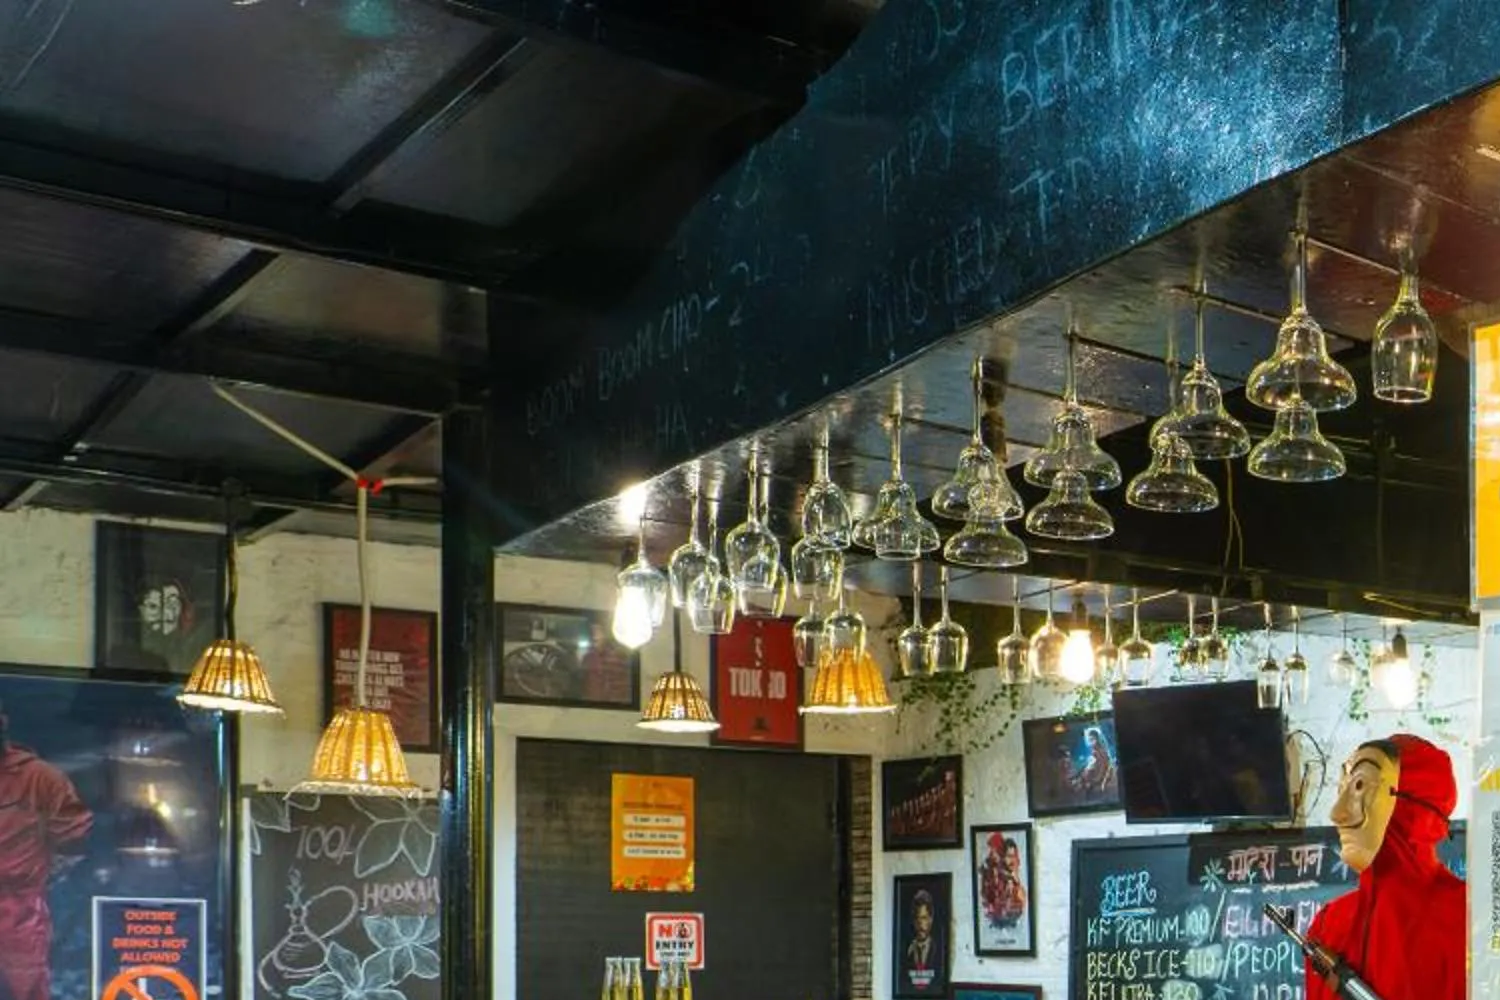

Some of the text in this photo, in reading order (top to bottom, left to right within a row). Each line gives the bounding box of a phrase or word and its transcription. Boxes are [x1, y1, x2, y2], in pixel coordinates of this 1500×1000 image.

[1101, 871, 1157, 910] BEER
[127, 924, 162, 935] FOOD
[655, 940, 694, 951] ENTRY
[121, 951, 181, 963] ALLOWED
[1232, 941, 1306, 981] PEOPL
